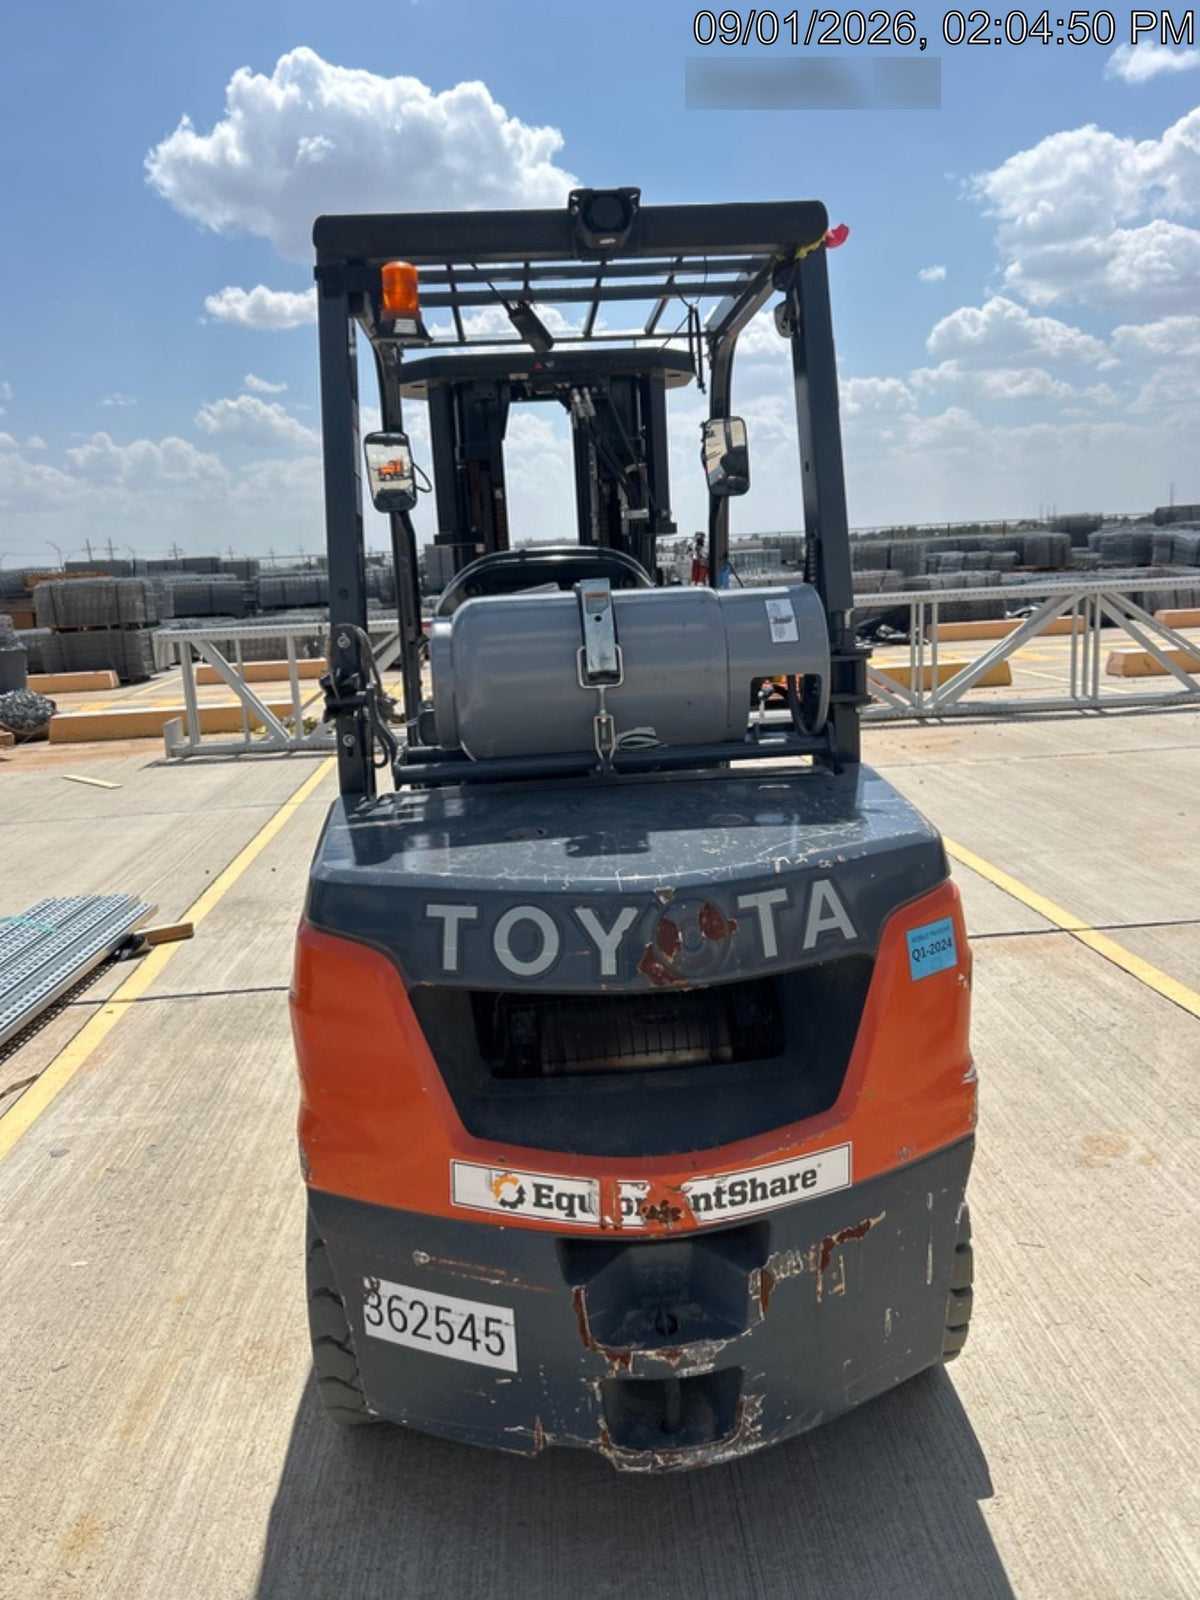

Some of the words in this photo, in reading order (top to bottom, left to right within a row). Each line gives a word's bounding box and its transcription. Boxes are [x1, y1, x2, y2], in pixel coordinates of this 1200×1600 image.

[426, 879, 858, 977] TOYOTA
[912, 937, 952, 962] Q1-2024
[366, 1290, 505, 1356] 362545
